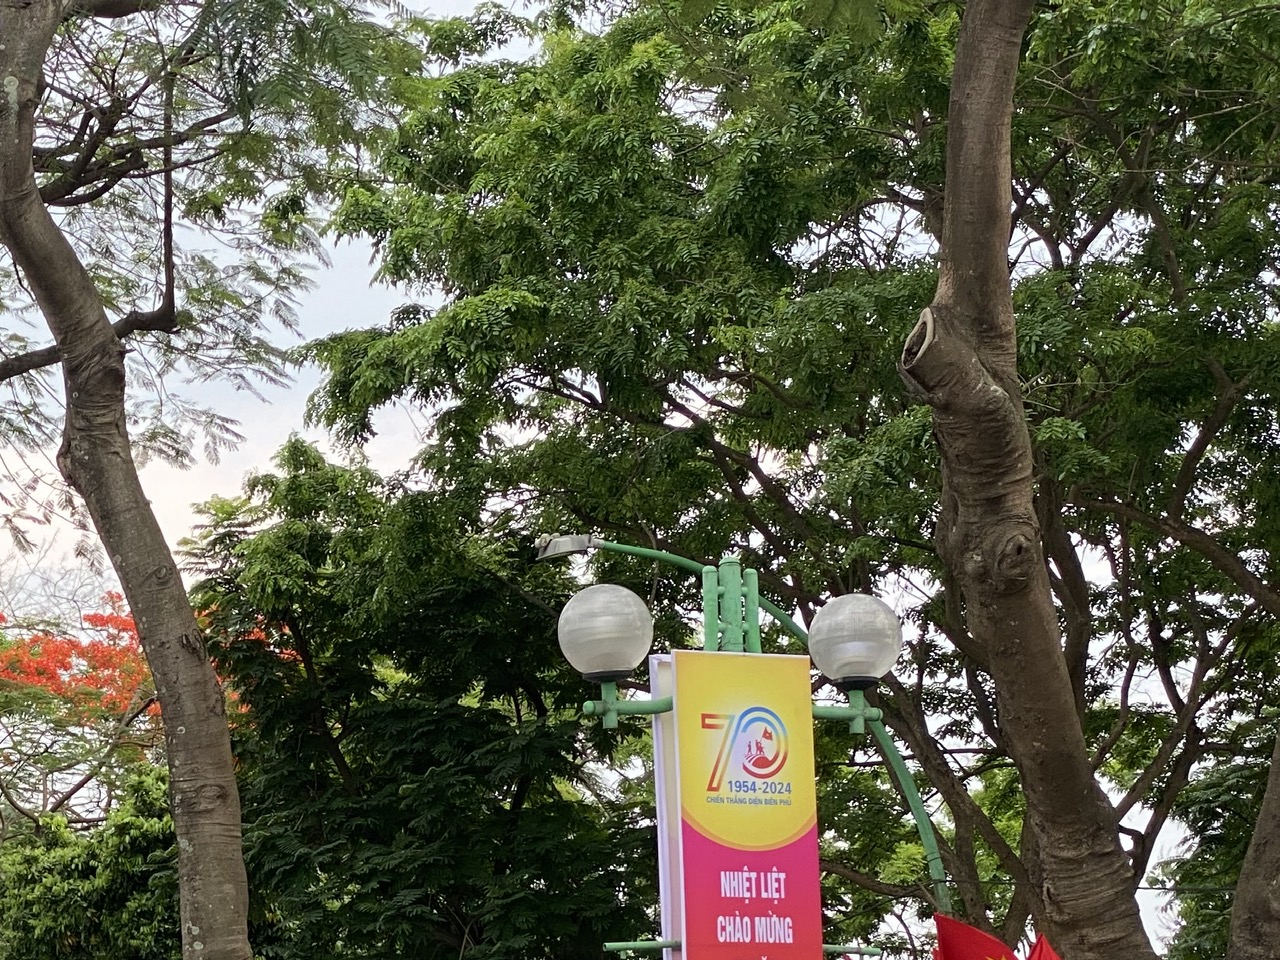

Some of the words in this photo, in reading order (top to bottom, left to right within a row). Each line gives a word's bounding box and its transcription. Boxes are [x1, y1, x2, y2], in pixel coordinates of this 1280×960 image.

[728, 780, 792, 794] 1954-2024
[720, 865, 757, 904] NHIỆT
[760, 866, 786, 904] LIỆT
[717, 910, 751, 943] CHÀO
[754, 910, 793, 944] MỪNG
